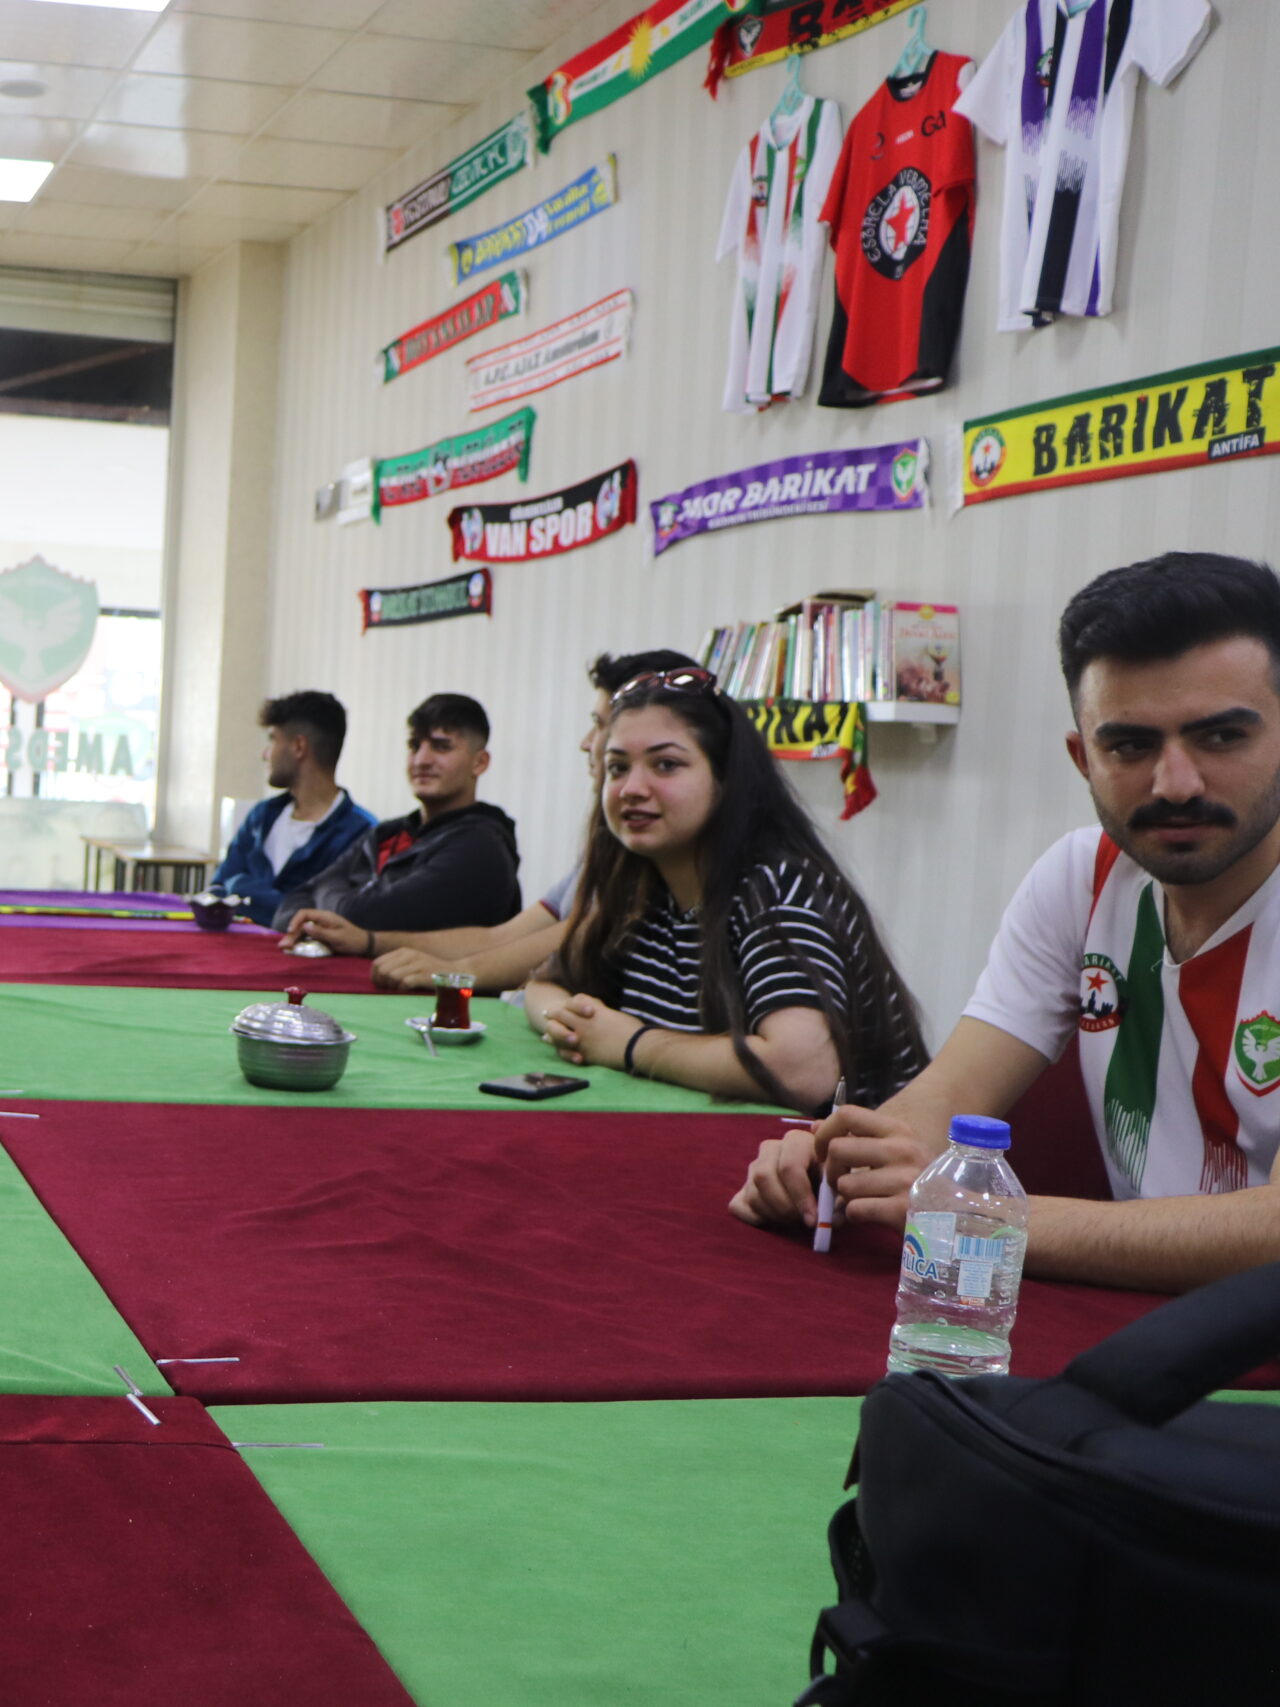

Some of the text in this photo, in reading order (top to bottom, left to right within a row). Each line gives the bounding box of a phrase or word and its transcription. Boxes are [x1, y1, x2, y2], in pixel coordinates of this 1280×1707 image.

[1211, 433, 1261, 458] ANTİFA
[679, 461, 877, 522] MOR BARİKAT
[485, 521, 527, 558] VAN
[529, 500, 595, 555] SPOR
